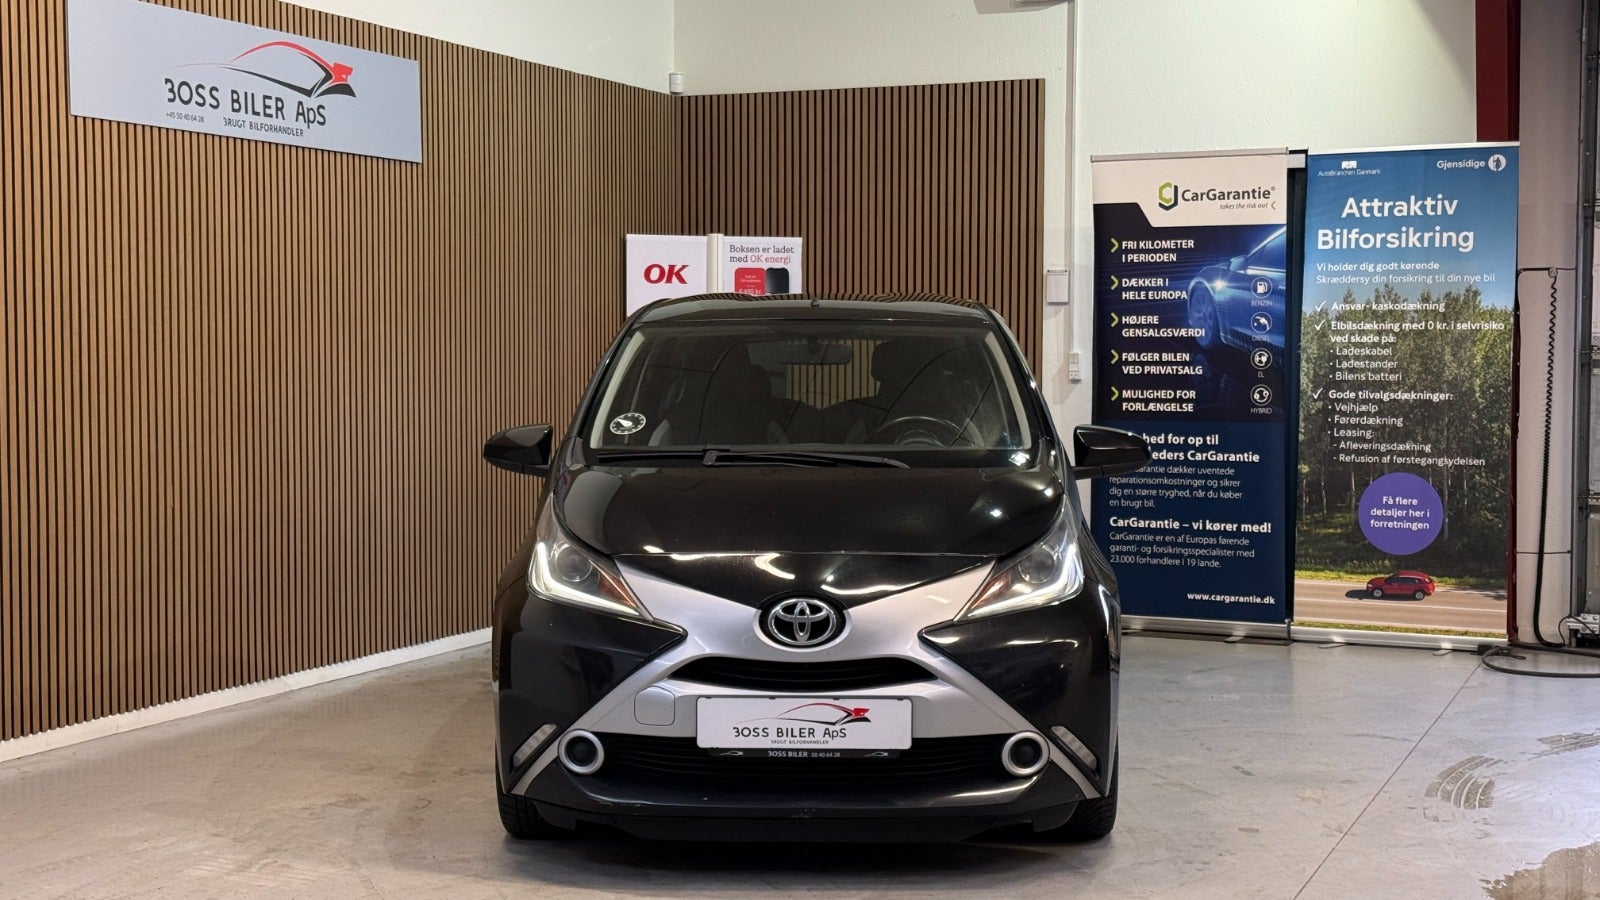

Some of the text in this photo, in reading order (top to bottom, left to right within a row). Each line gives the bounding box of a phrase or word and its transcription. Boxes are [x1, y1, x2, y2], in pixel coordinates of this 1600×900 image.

[231, 89, 285, 120] BILER
[295, 101, 327, 129] ApS
[249, 121, 304, 137] BILFORHANDLER
[1437, 160, 1486, 170] Gjensidige
[1342, 194, 1458, 218] Attraktiv
[1318, 226, 1474, 252] Bilforsikring
[730, 244, 760, 254] Boksen
[773, 245, 794, 254] ladet
[1122, 240, 1194, 249] FRI KILOMETER
[730, 255, 792, 266] med OK energi
[1128, 253, 1177, 262] PERIODEN
[1317, 262, 1440, 272] Vi holder dig godt kørende
[644, 264, 689, 284] OK
[1316, 276, 1370, 285] Skræddersy
[1389, 275, 1433, 284] forsikring
[1447, 274, 1461, 282] din
[1464, 275, 1481, 284] nye
[1484, 273, 1496, 282] bil
[1122, 278, 1162, 287] DÆKKER
[1122, 291, 1188, 300] HELE EUROPA
[1332, 302, 1445, 312] Ansvar- kaskodækning
[1122, 315, 1159, 325] HØJERE
[1331, 321, 1400, 332] Elbilsdækning
[1402, 321, 1425, 330] med
[1428, 321, 1434, 330] 0
[1436, 321, 1449, 330] kr.
[1456, 321, 1504, 330] selvrisiko
[1122, 328, 1205, 338] GENSALGSVÆRDI
[1331, 334, 1397, 344] ved skade på:
[1336, 347, 1392, 356] Ladeskabel
[1122, 352, 1190, 362] FØLGER BILEN
[1336, 359, 1398, 368] Ladestander
[1122, 366, 1203, 375] VED PRIVATSALG
[1335, 372, 1402, 381] Bilens batteri
[1122, 390, 1196, 399] MULIGHED FOR
[1329, 390, 1453, 401] Gode tilvalgsdækninger:
[1122, 402, 1194, 412] FORLÆNGELSE
[1335, 403, 1378, 413] Vejhjælp
[1334, 416, 1404, 427] Førerdækning
[1334, 428, 1375, 438] Leasing:
[1167, 434, 1185, 444] for
[1188, 436, 1203, 447] op
[1206, 434, 1219, 445] til
[1339, 441, 1431, 452] Afleveringsdækning
[1152, 450, 1260, 463] eders CarGarantie
[1339, 454, 1485, 466] Refusion af førstegangsydelsen
[1167, 466, 1196, 474] dækker
[1198, 467, 1235, 475] uventede
[1110, 476, 1205, 487] reparationsomkostninger
[1220, 478, 1240, 487] sikrer
[1110, 488, 1122, 496] dig
[1135, 488, 1157, 496] større
[1159, 488, 1191, 499] tryghed,
[1193, 489, 1205, 498] når
[1207, 490, 1218, 498] du
[1220, 490, 1243, 499] køber
[1121, 500, 1142, 509] brugt
[1383, 496, 1418, 505] Få flere
[1371, 508, 1406, 518] detaljer
[1409, 509, 1425, 518] her
[1110, 517, 1179, 529] CarGarantie
[1192, 520, 1203, 530] vi
[1206, 520, 1239, 531] kører
[1241, 522, 1271, 533] med!
[1370, 520, 1429, 529] forretningen
[1110, 532, 1154, 542] CarGarantie
[1177, 534, 1185, 543] af
[1186, 536, 1217, 546] Europas
[1219, 536, 1249, 545] førende
[1110, 544, 1139, 554] garanti-
[1153, 546, 1234, 558] forsikringsspecialister
[1237, 549, 1254, 557] med
[1110, 555, 1135, 563] 23.000
[1137, 556, 1180, 566] forhandlere
[1198, 559, 1221, 568] lande.
[1187, 592, 1275, 605] www.cargarantie.dk
[777, 728, 815, 738] BILER
[823, 728, 847, 740] ApS
